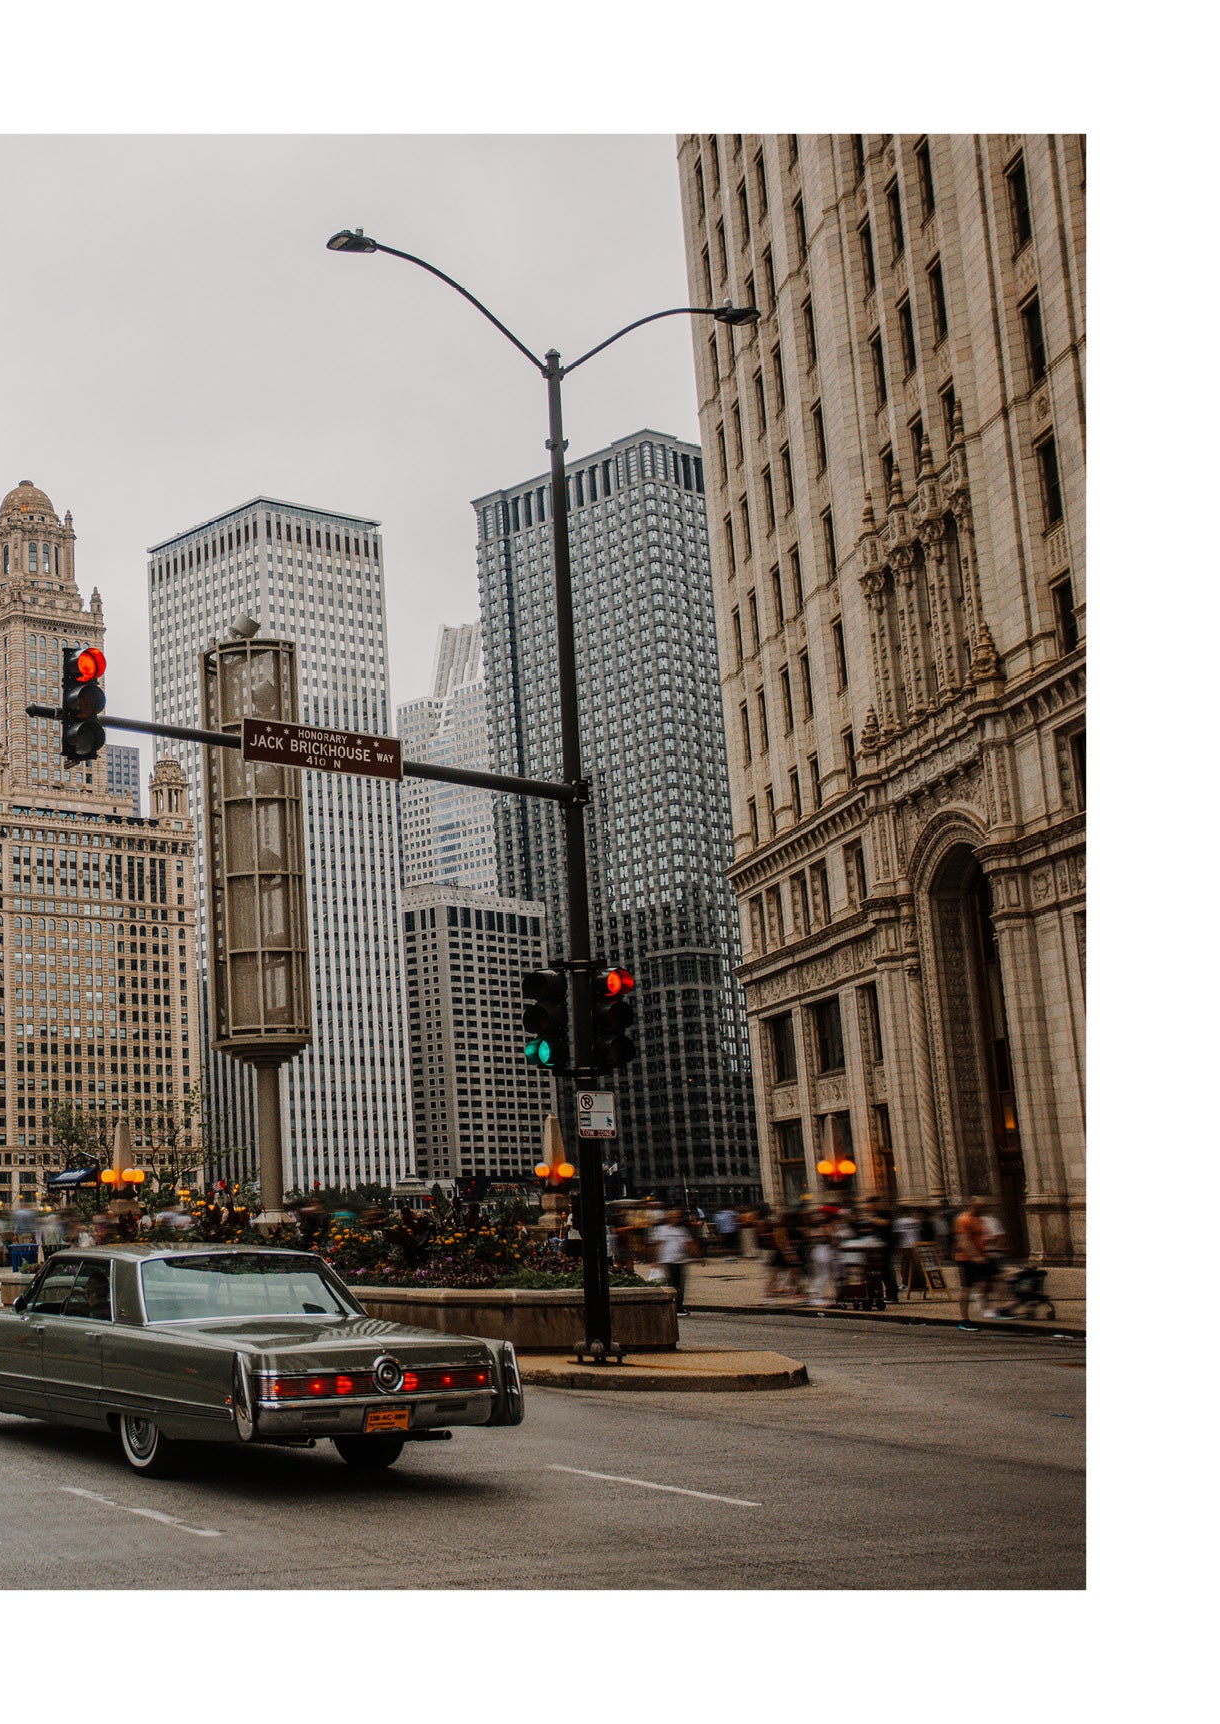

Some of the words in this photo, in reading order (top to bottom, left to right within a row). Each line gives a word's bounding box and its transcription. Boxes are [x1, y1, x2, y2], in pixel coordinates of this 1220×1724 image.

[298, 729, 347, 744] HONORARY
[250, 734, 284, 750] JACK
[290, 739, 371, 762] BRICKHOUSE
[376, 752, 394, 763] WAY
[306, 756, 326, 766] 410
[333, 760, 341, 769] N
